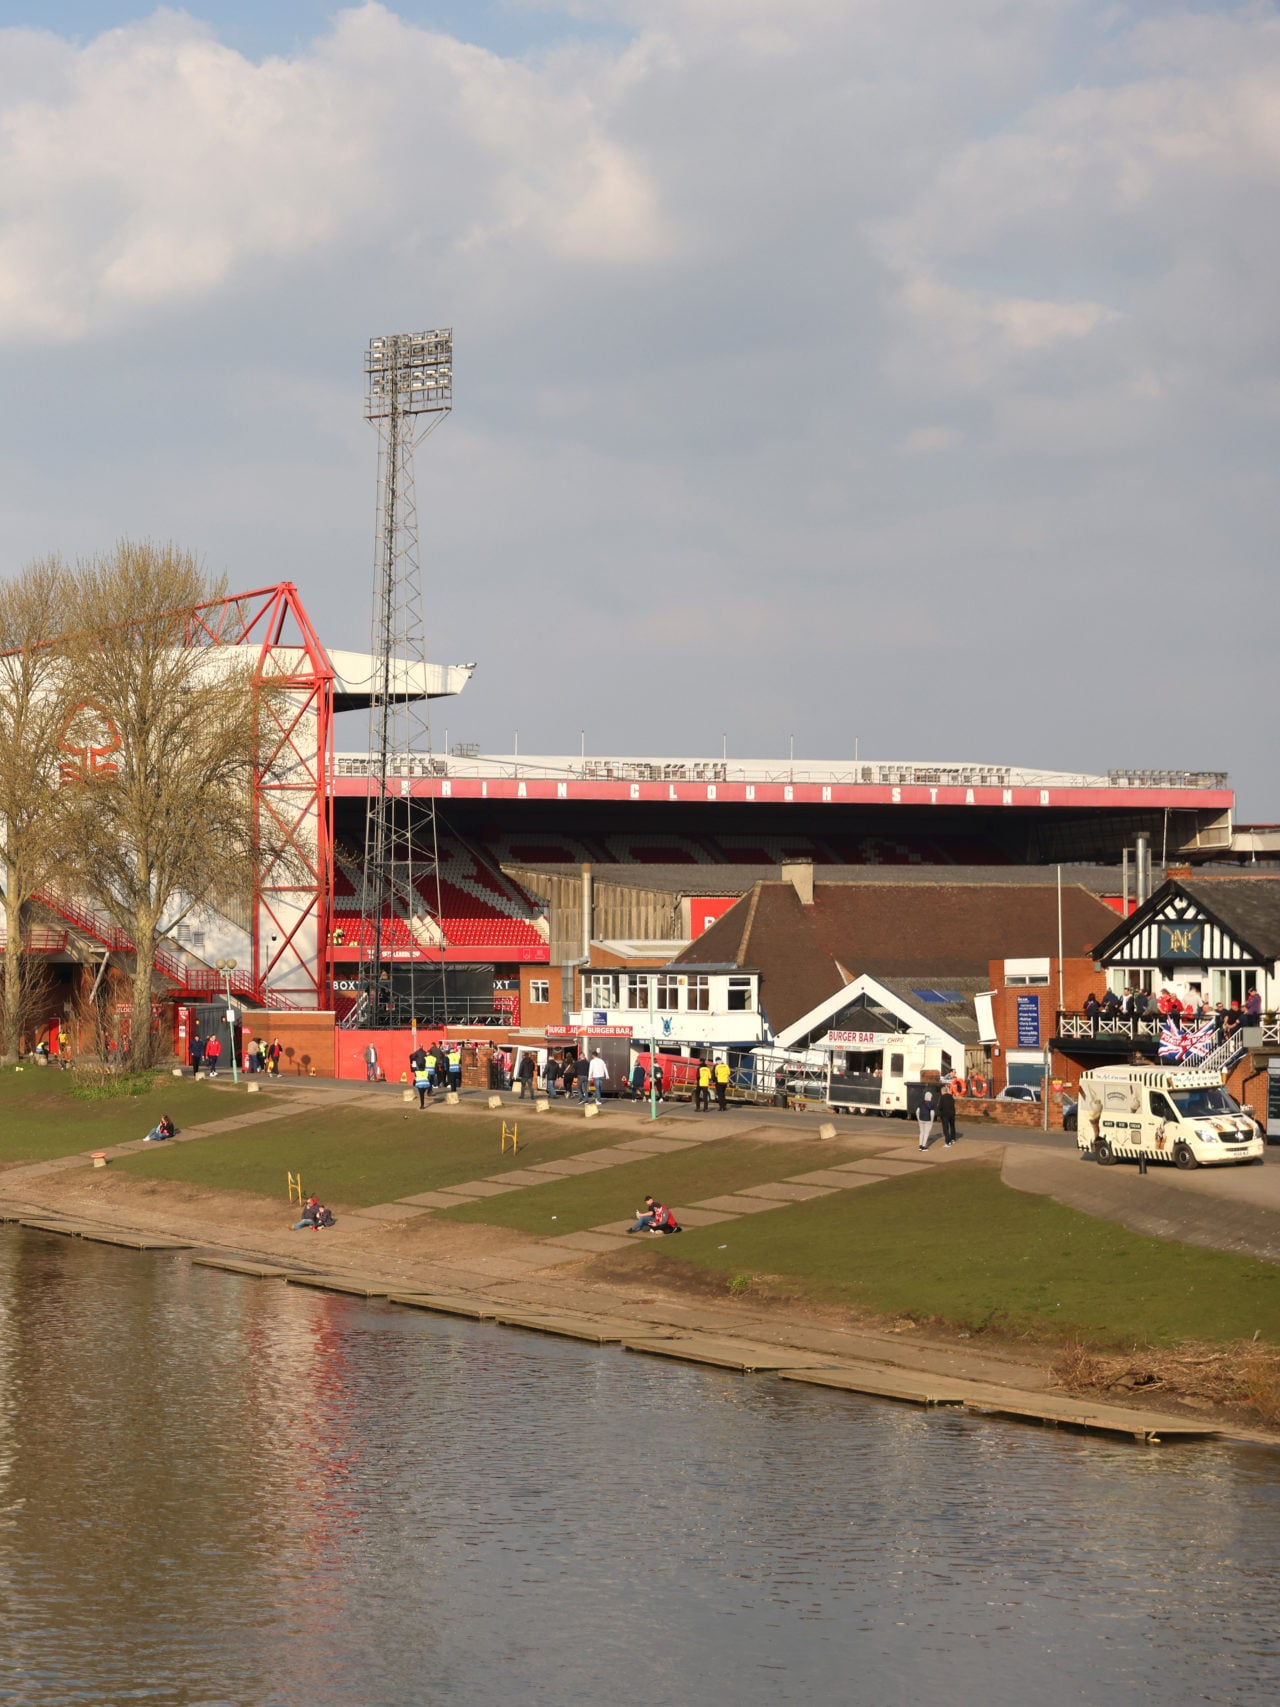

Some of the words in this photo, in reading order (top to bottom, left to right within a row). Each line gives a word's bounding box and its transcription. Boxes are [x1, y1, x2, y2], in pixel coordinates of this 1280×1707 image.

[401, 780, 567, 797] BRIAN
[630, 783, 832, 801] CLOUGH
[892, 787, 1049, 804] STAND
[829, 1031, 856, 1041] BURGER
[858, 1032, 874, 1043] BAR
